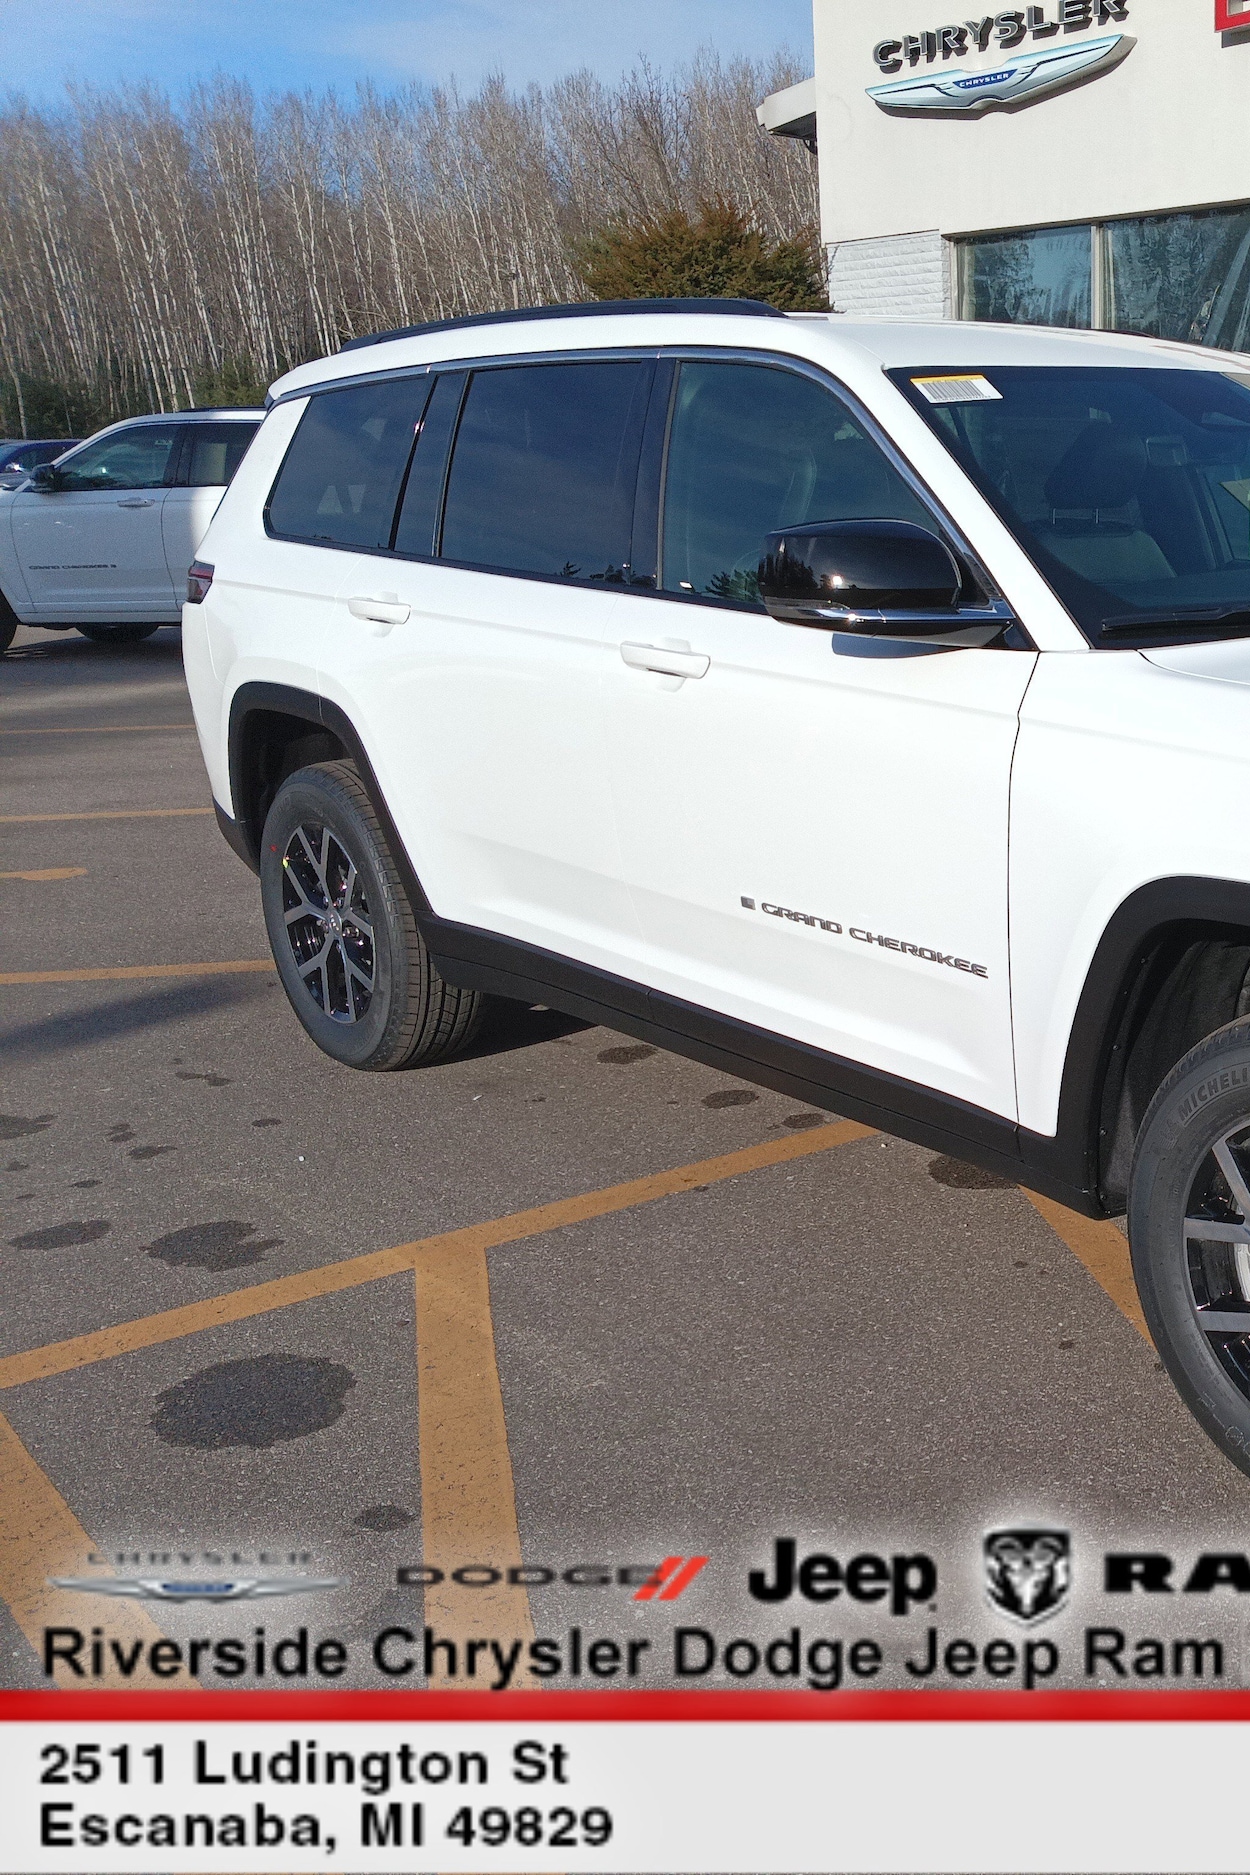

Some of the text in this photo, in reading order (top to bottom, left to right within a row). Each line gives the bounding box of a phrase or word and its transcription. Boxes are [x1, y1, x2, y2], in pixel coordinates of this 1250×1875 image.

[872, 0, 1124, 68] CHRYSLER
[958, 72, 1010, 88] CHRYSLER
[761, 902, 842, 934] GRAND
[849, 927, 989, 979] CHEROKEE
